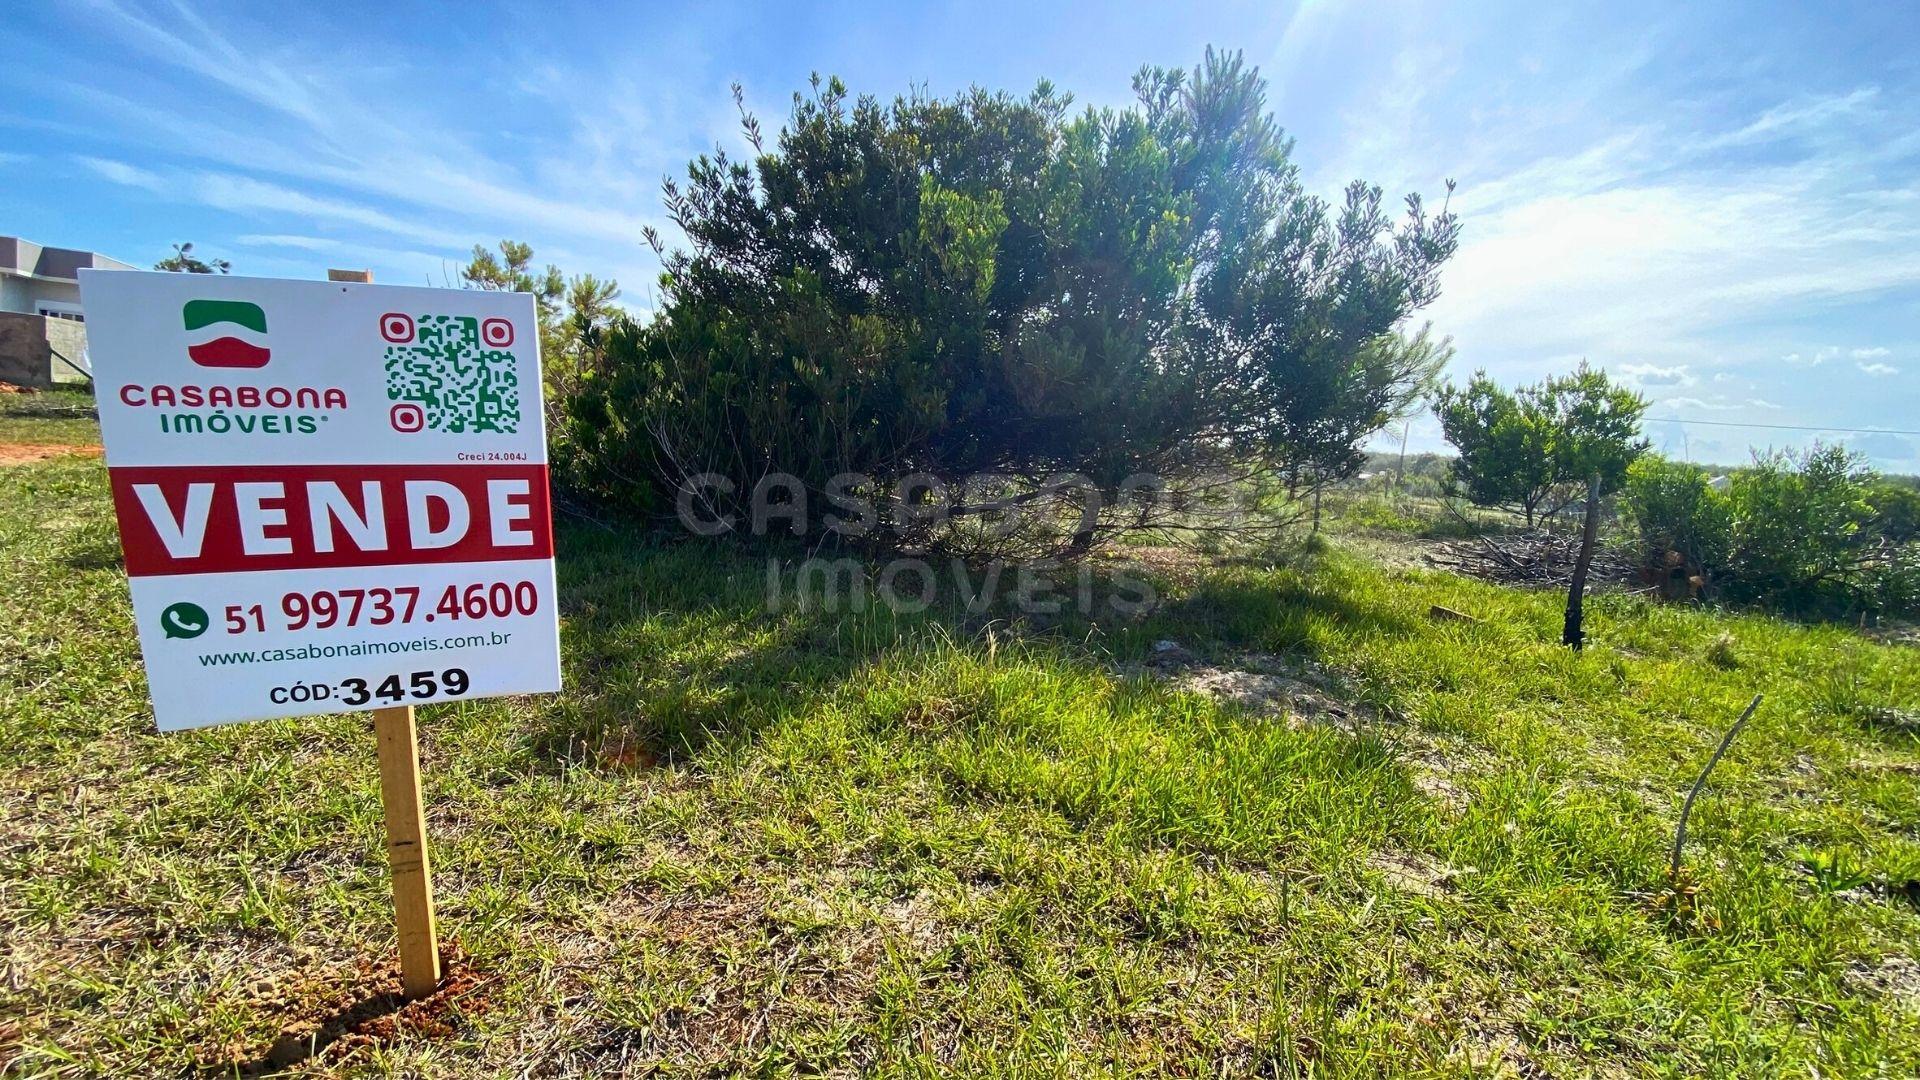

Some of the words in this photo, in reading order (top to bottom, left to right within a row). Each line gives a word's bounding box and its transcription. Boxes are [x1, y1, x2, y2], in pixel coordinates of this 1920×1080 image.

[120, 384, 348, 409] CASABONA
[457, 451, 486, 461] Creci
[488, 451, 528, 462] 24.004J
[132, 479, 536, 559] VENDE
[225, 604, 266, 634] 51
[281, 580, 539, 631] 99737.4600
[199, 631, 512, 667] www.casabonaimoveis.com.br
